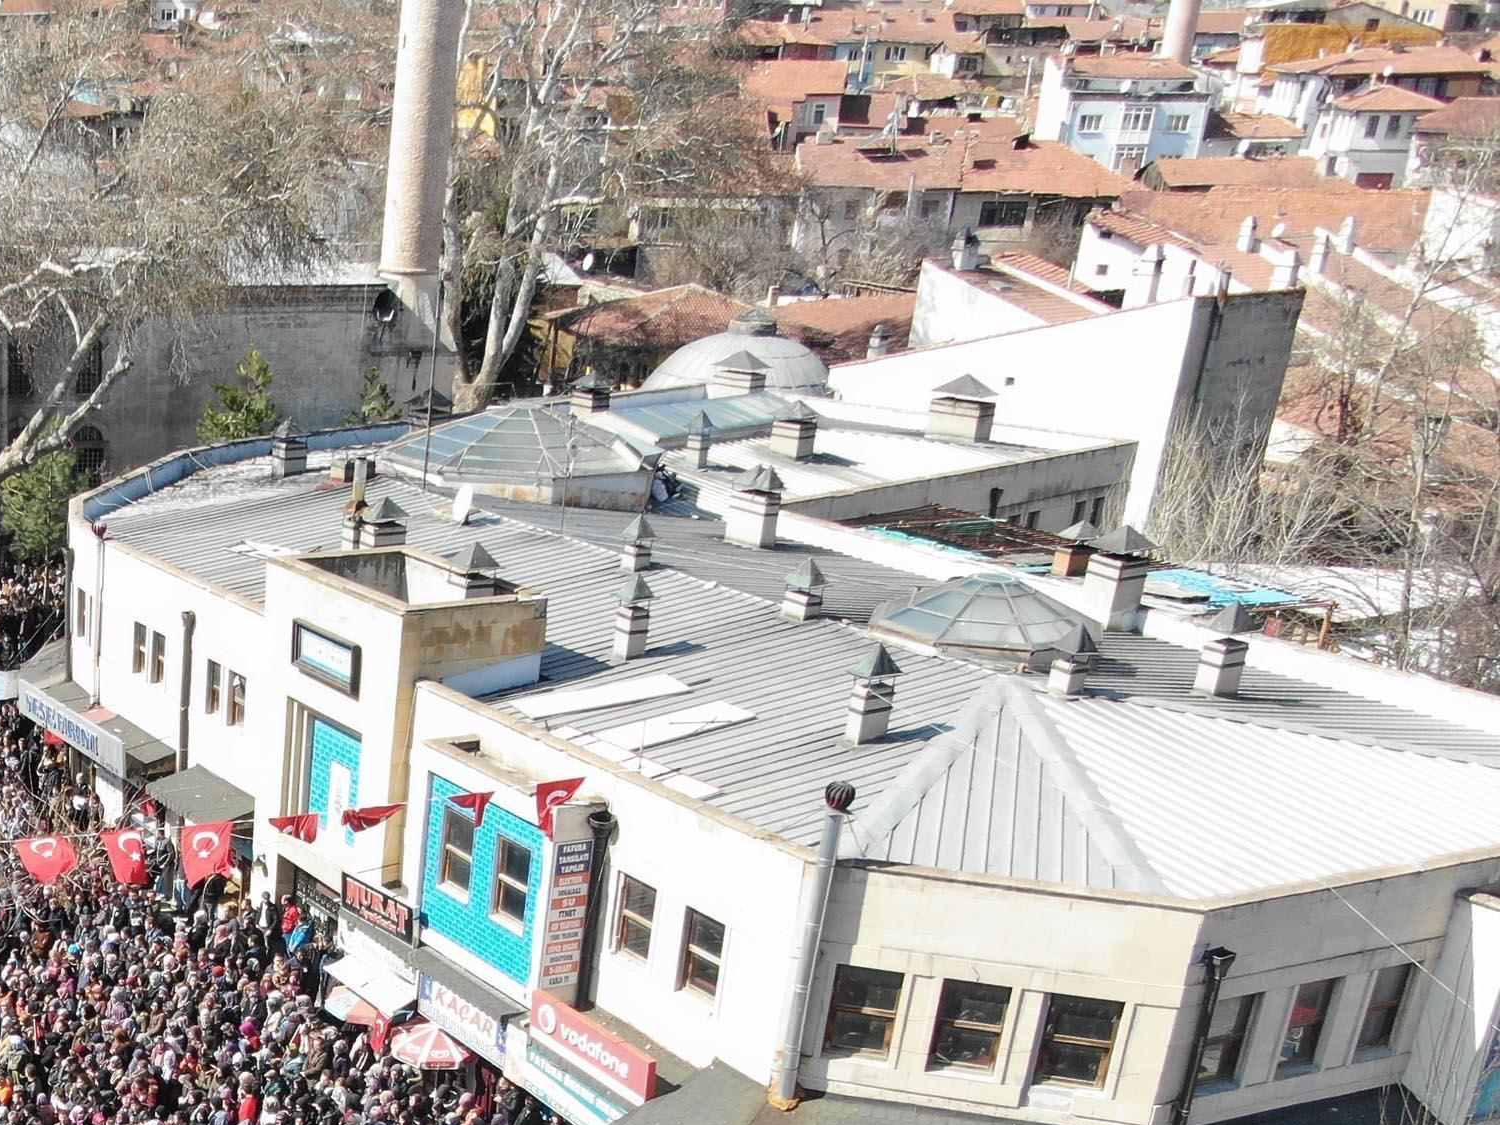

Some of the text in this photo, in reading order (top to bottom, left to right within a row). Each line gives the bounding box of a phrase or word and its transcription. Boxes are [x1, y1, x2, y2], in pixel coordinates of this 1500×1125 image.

[346, 878, 409, 936] MURAT
[562, 897, 576, 908] SU
[436, 988, 493, 1039] KAÇAR
[560, 1022, 629, 1079] vodafone
